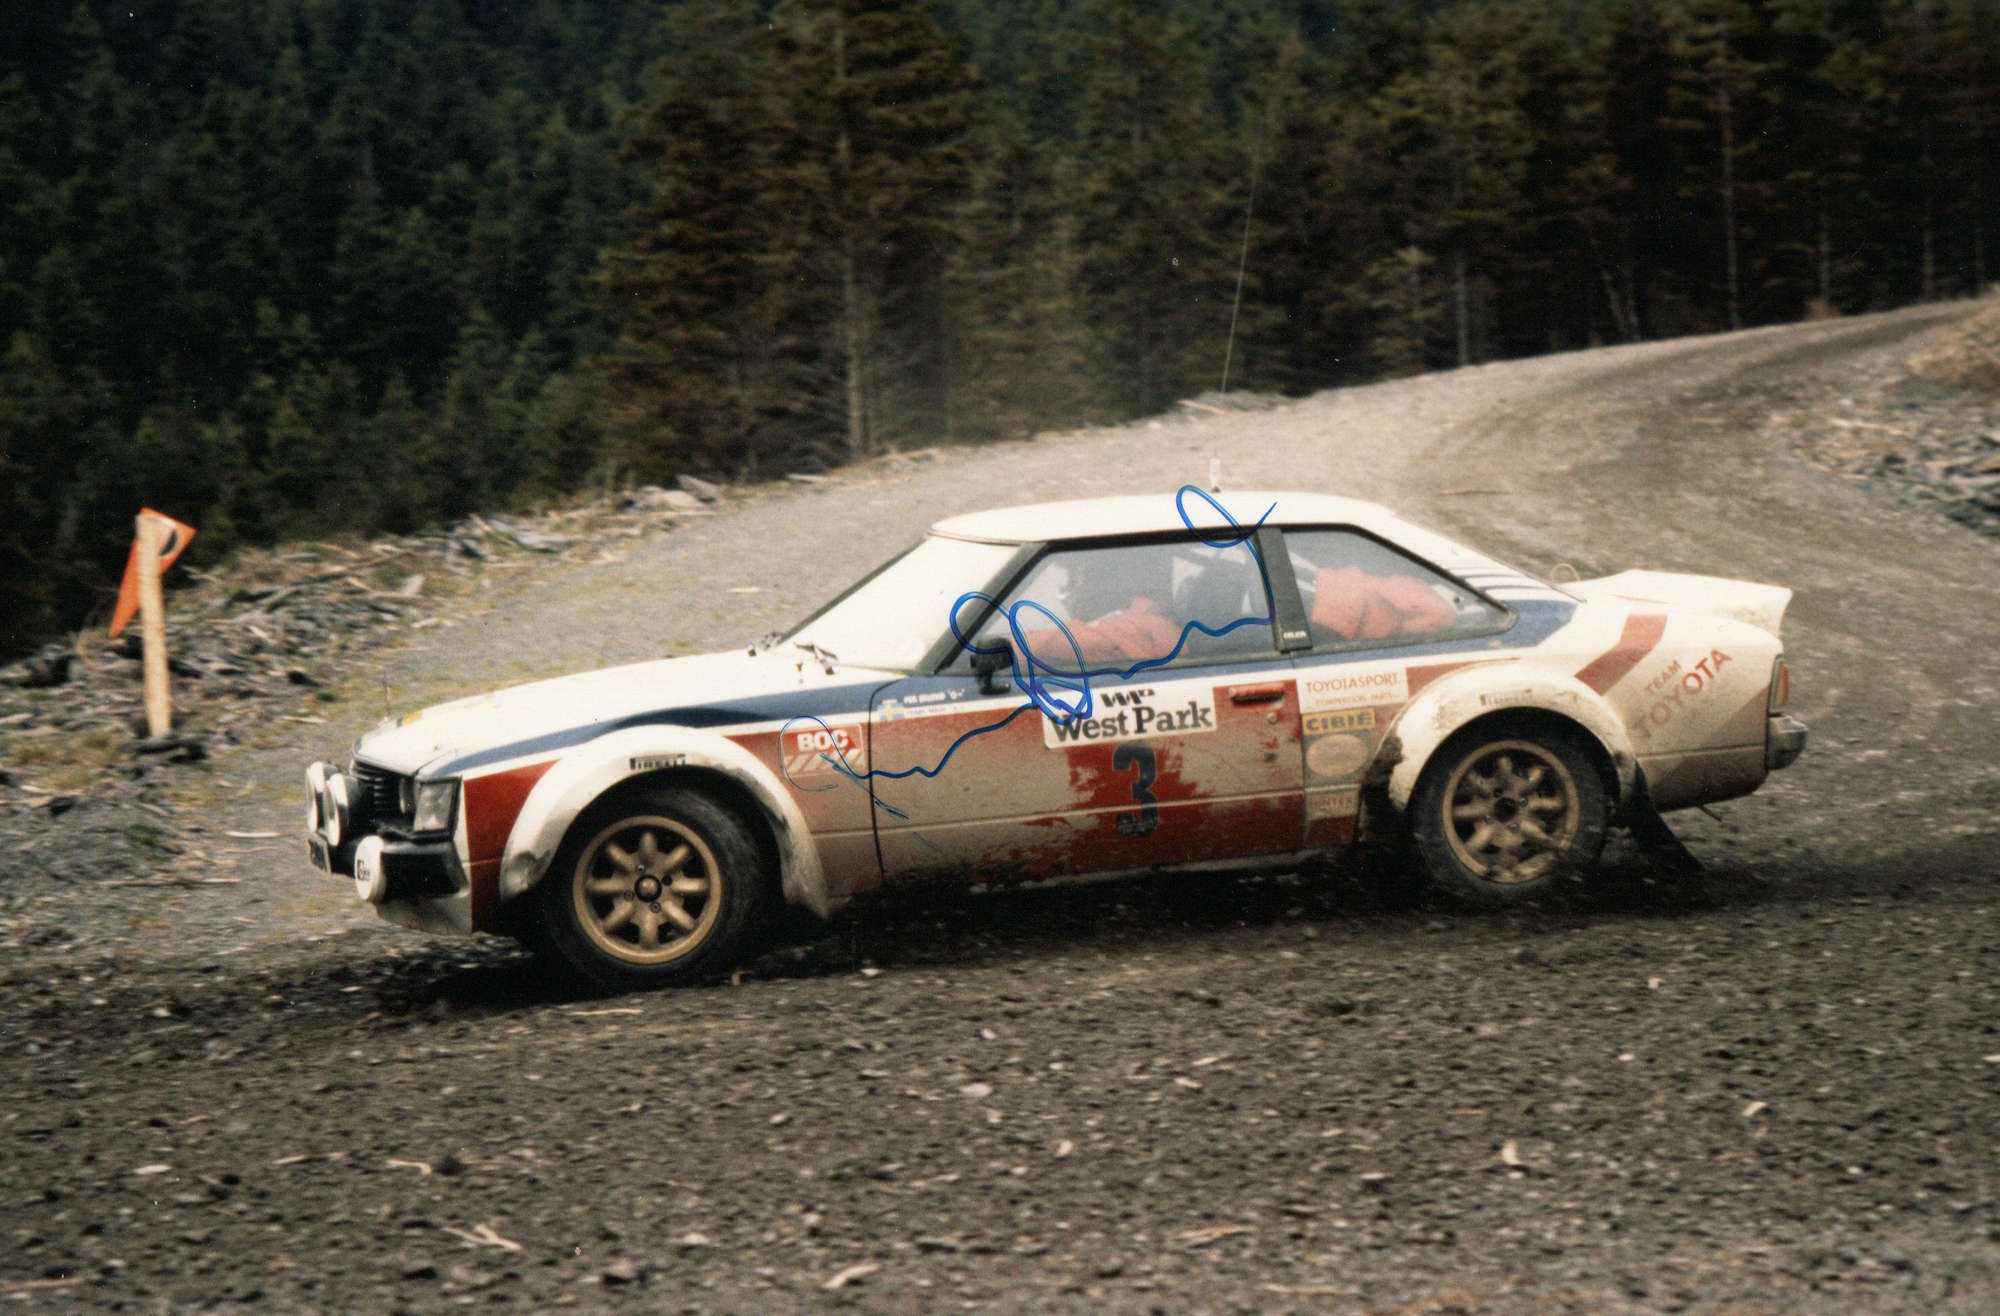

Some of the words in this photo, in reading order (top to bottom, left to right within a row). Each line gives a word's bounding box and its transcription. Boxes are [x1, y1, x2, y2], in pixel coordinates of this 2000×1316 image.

[1306, 672, 1398, 693] TOYOTASPORT
[1627, 649, 1733, 739] TOYOTA
[1644, 659, 1682, 695] TEAM
[797, 729, 849, 751] BOC
[1049, 710, 1129, 742] West
[1132, 701, 1213, 735] Park
[1112, 743, 1159, 838] 3
